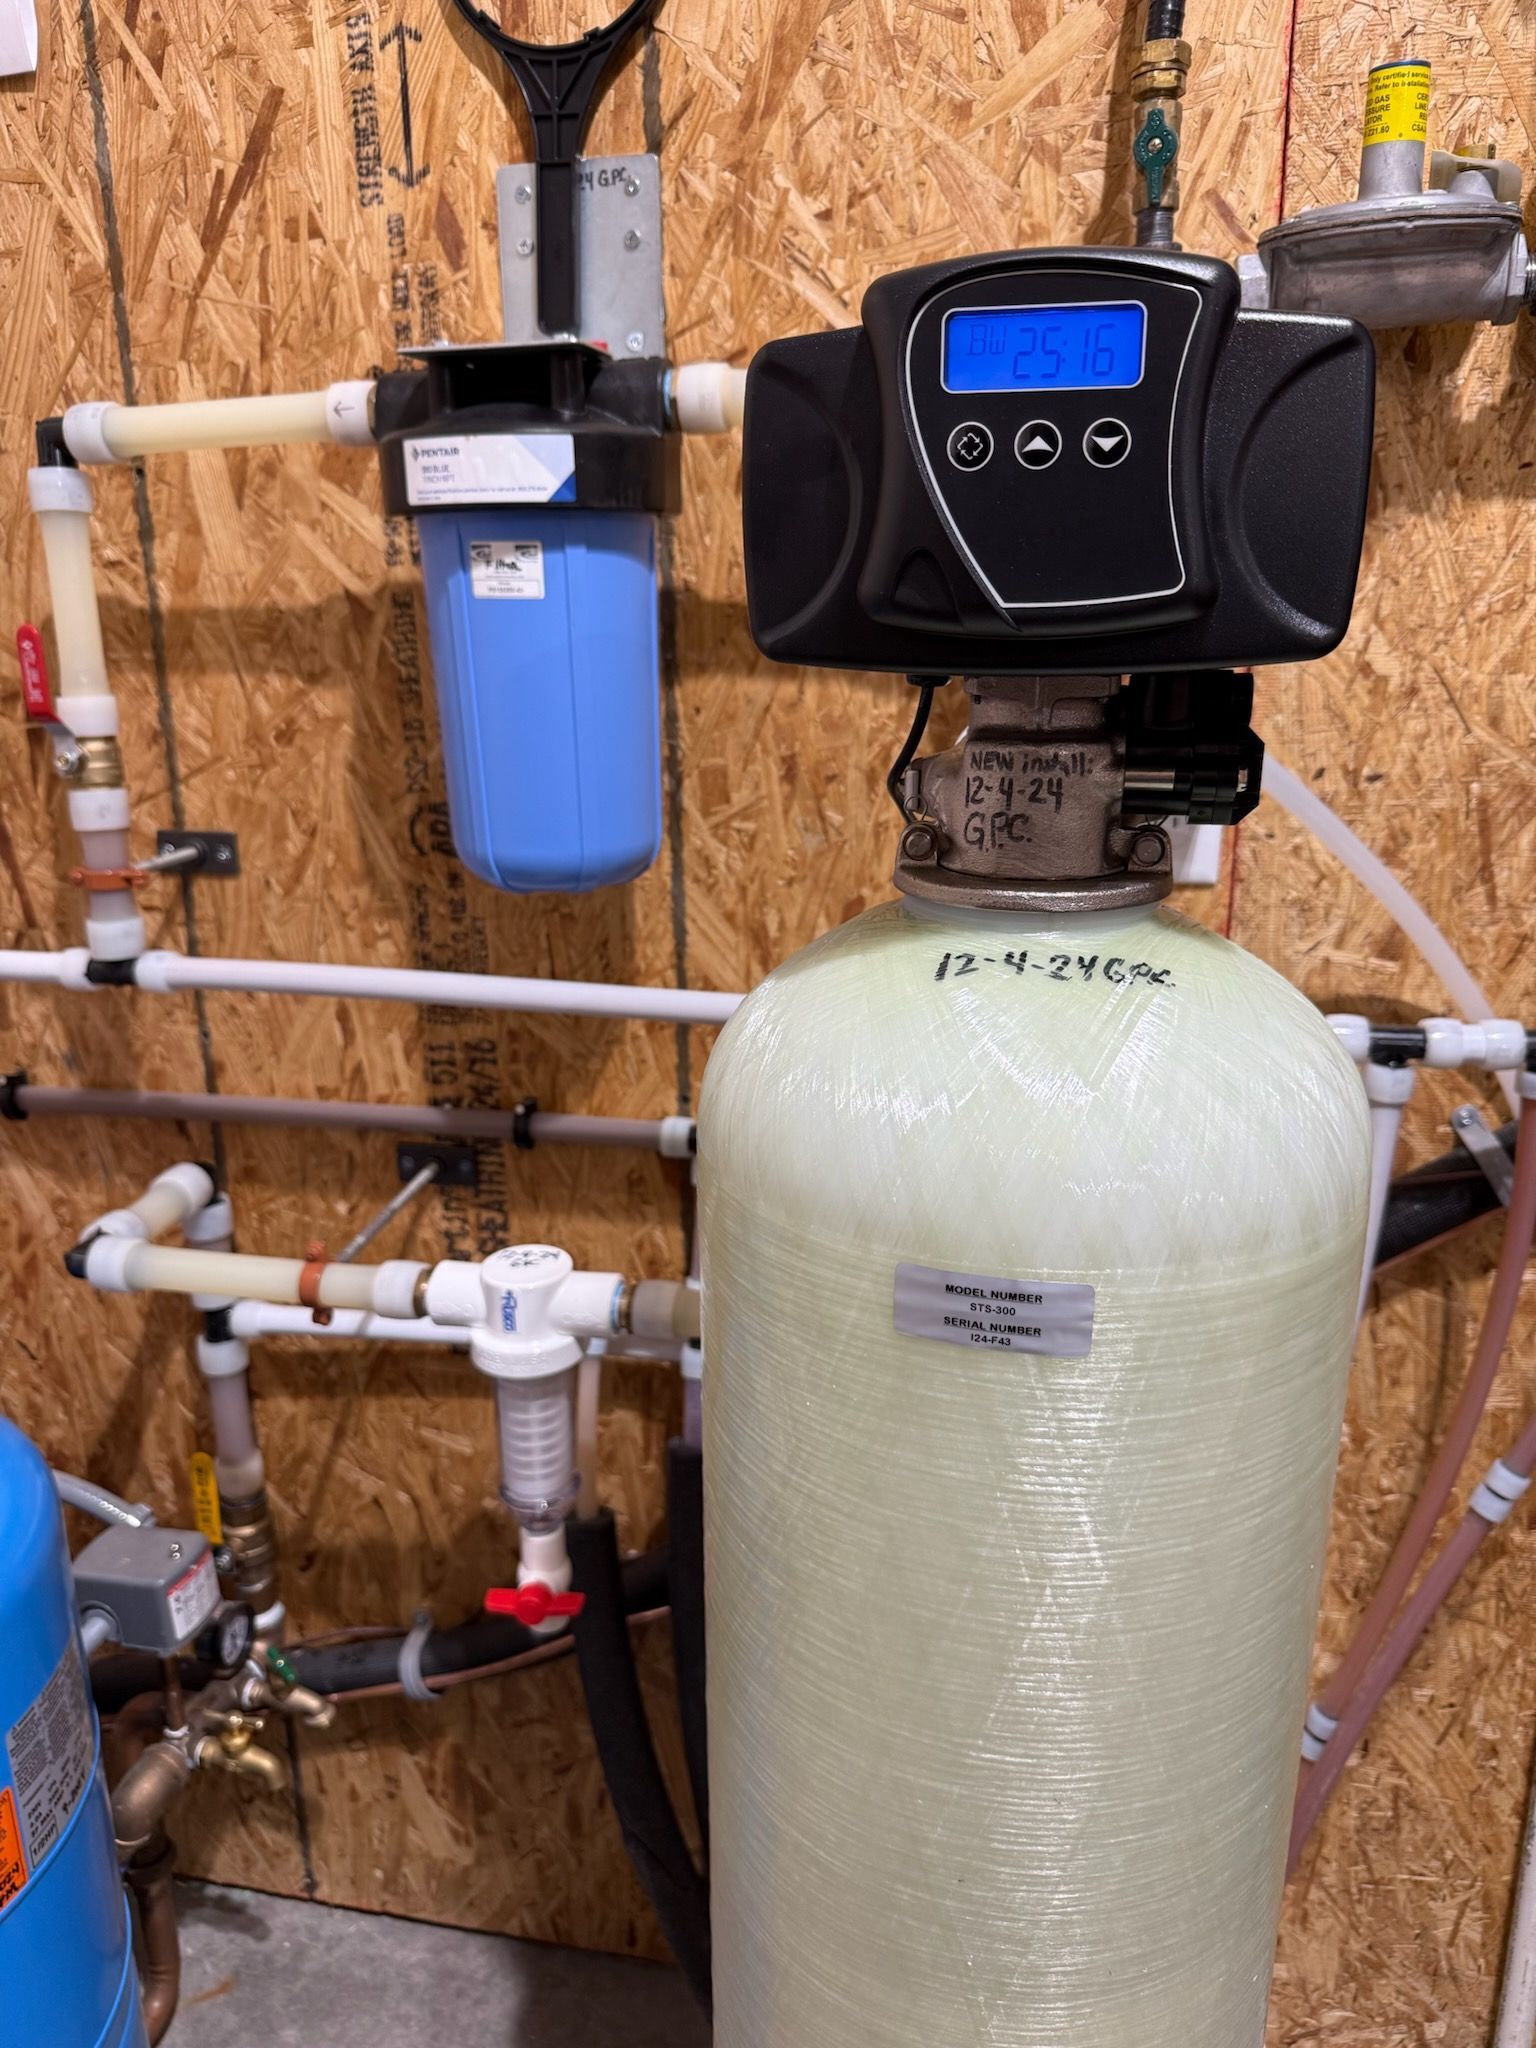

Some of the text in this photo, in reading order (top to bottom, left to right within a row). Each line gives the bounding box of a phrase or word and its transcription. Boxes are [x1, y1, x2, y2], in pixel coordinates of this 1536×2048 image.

[1375, 94, 1390, 104] GAS
[346, 12, 385, 208] STRENGTH AXIS
[967, 322, 1117, 380] BW 25:16
[970, 750, 1015, 772] NEW
[965, 775, 1065, 814] 12-4-24
[944, 1284, 1044, 1304] MODEL NUMBER
[970, 1303, 1016, 1316] STS-300
[944, 1316, 1042, 1337] SERIAL NUMBER
